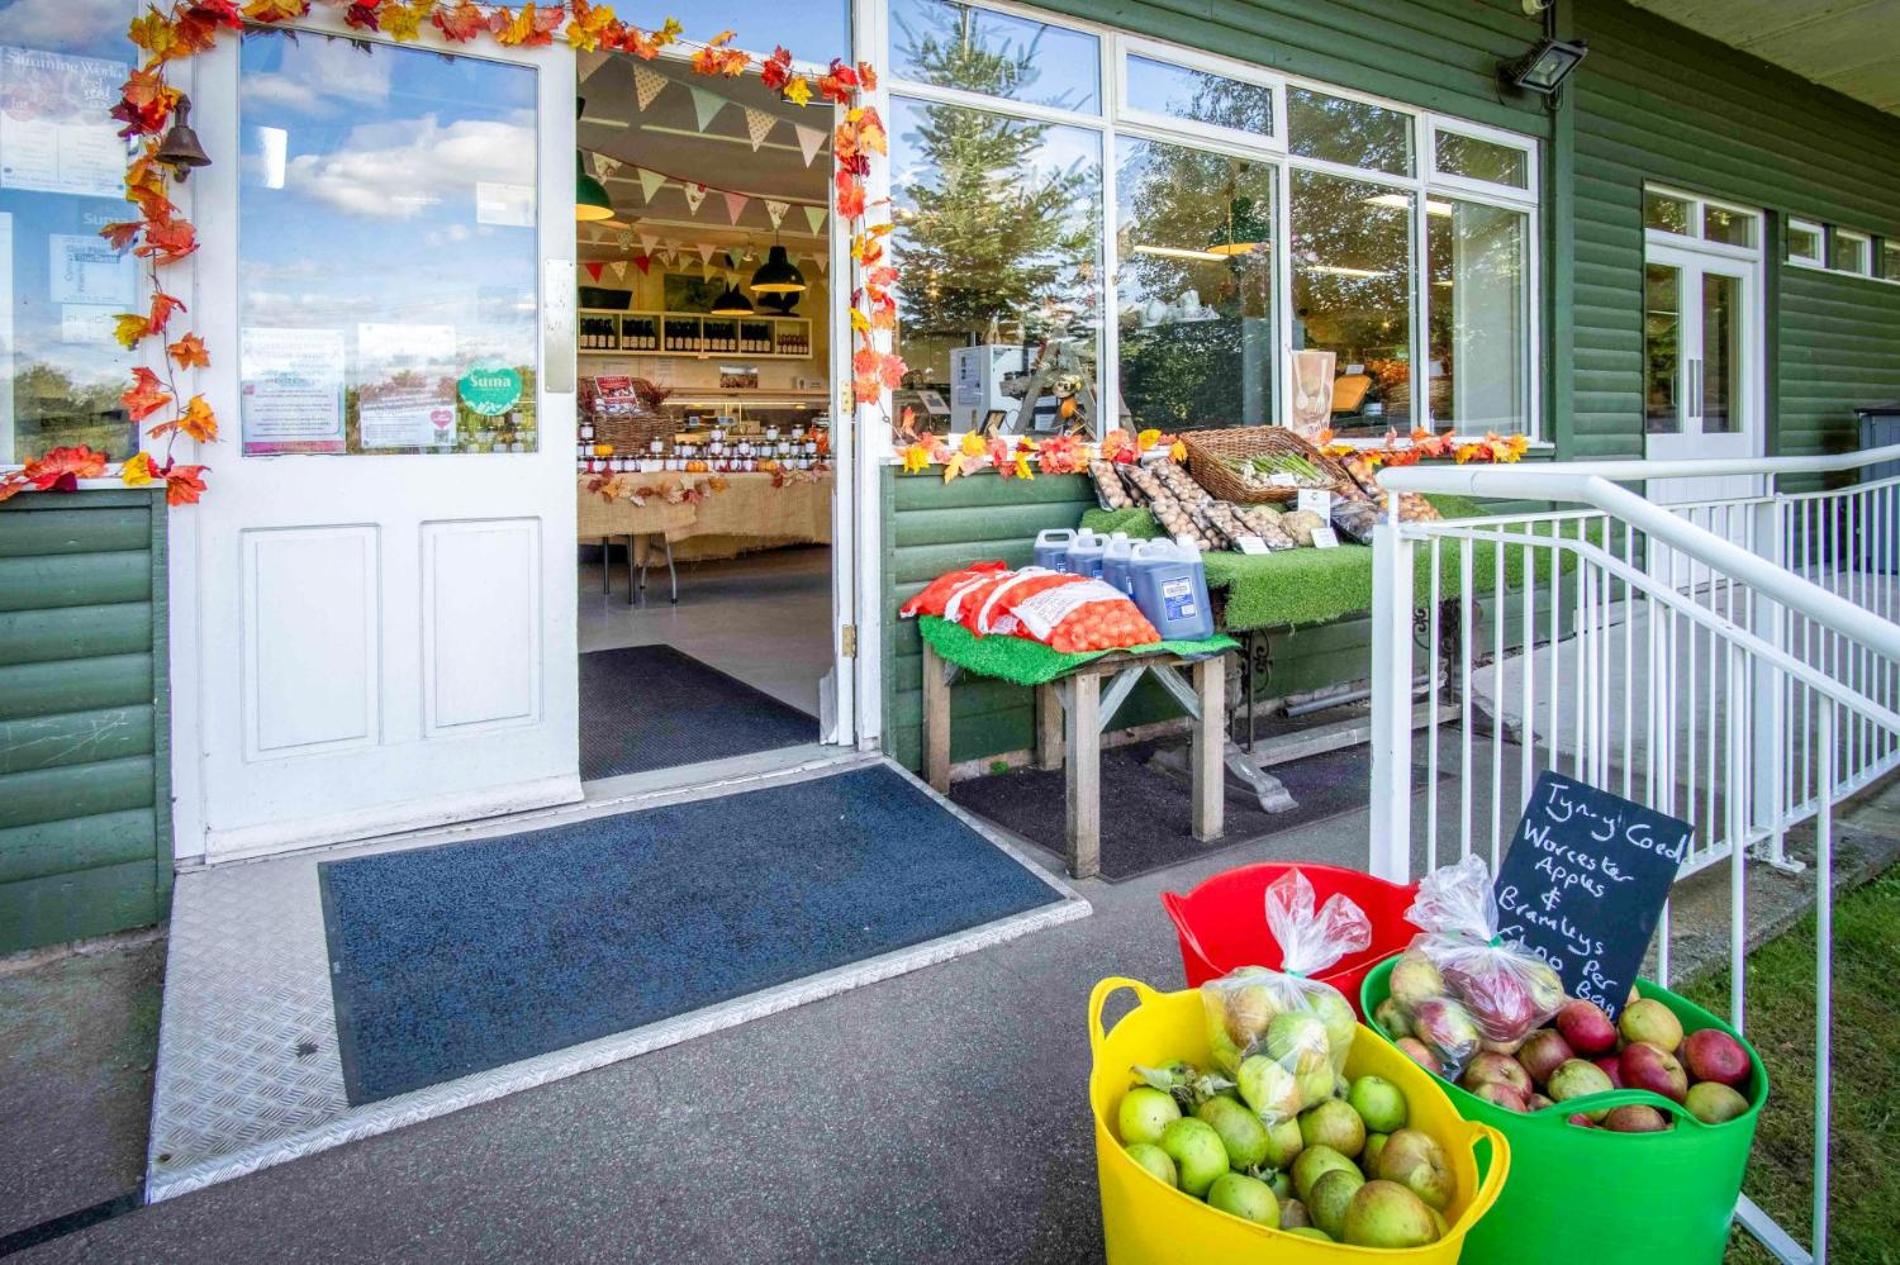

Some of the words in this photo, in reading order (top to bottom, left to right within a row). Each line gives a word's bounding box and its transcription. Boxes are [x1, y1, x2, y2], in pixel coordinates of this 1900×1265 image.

[470, 373, 511, 388] Suma
[1523, 819, 1635, 882] Worcester
[1626, 823, 1688, 864] Coed
[1535, 856, 1609, 899] Apples
[1541, 887, 1562, 912] &
[1498, 886, 1604, 956] Bramleys
